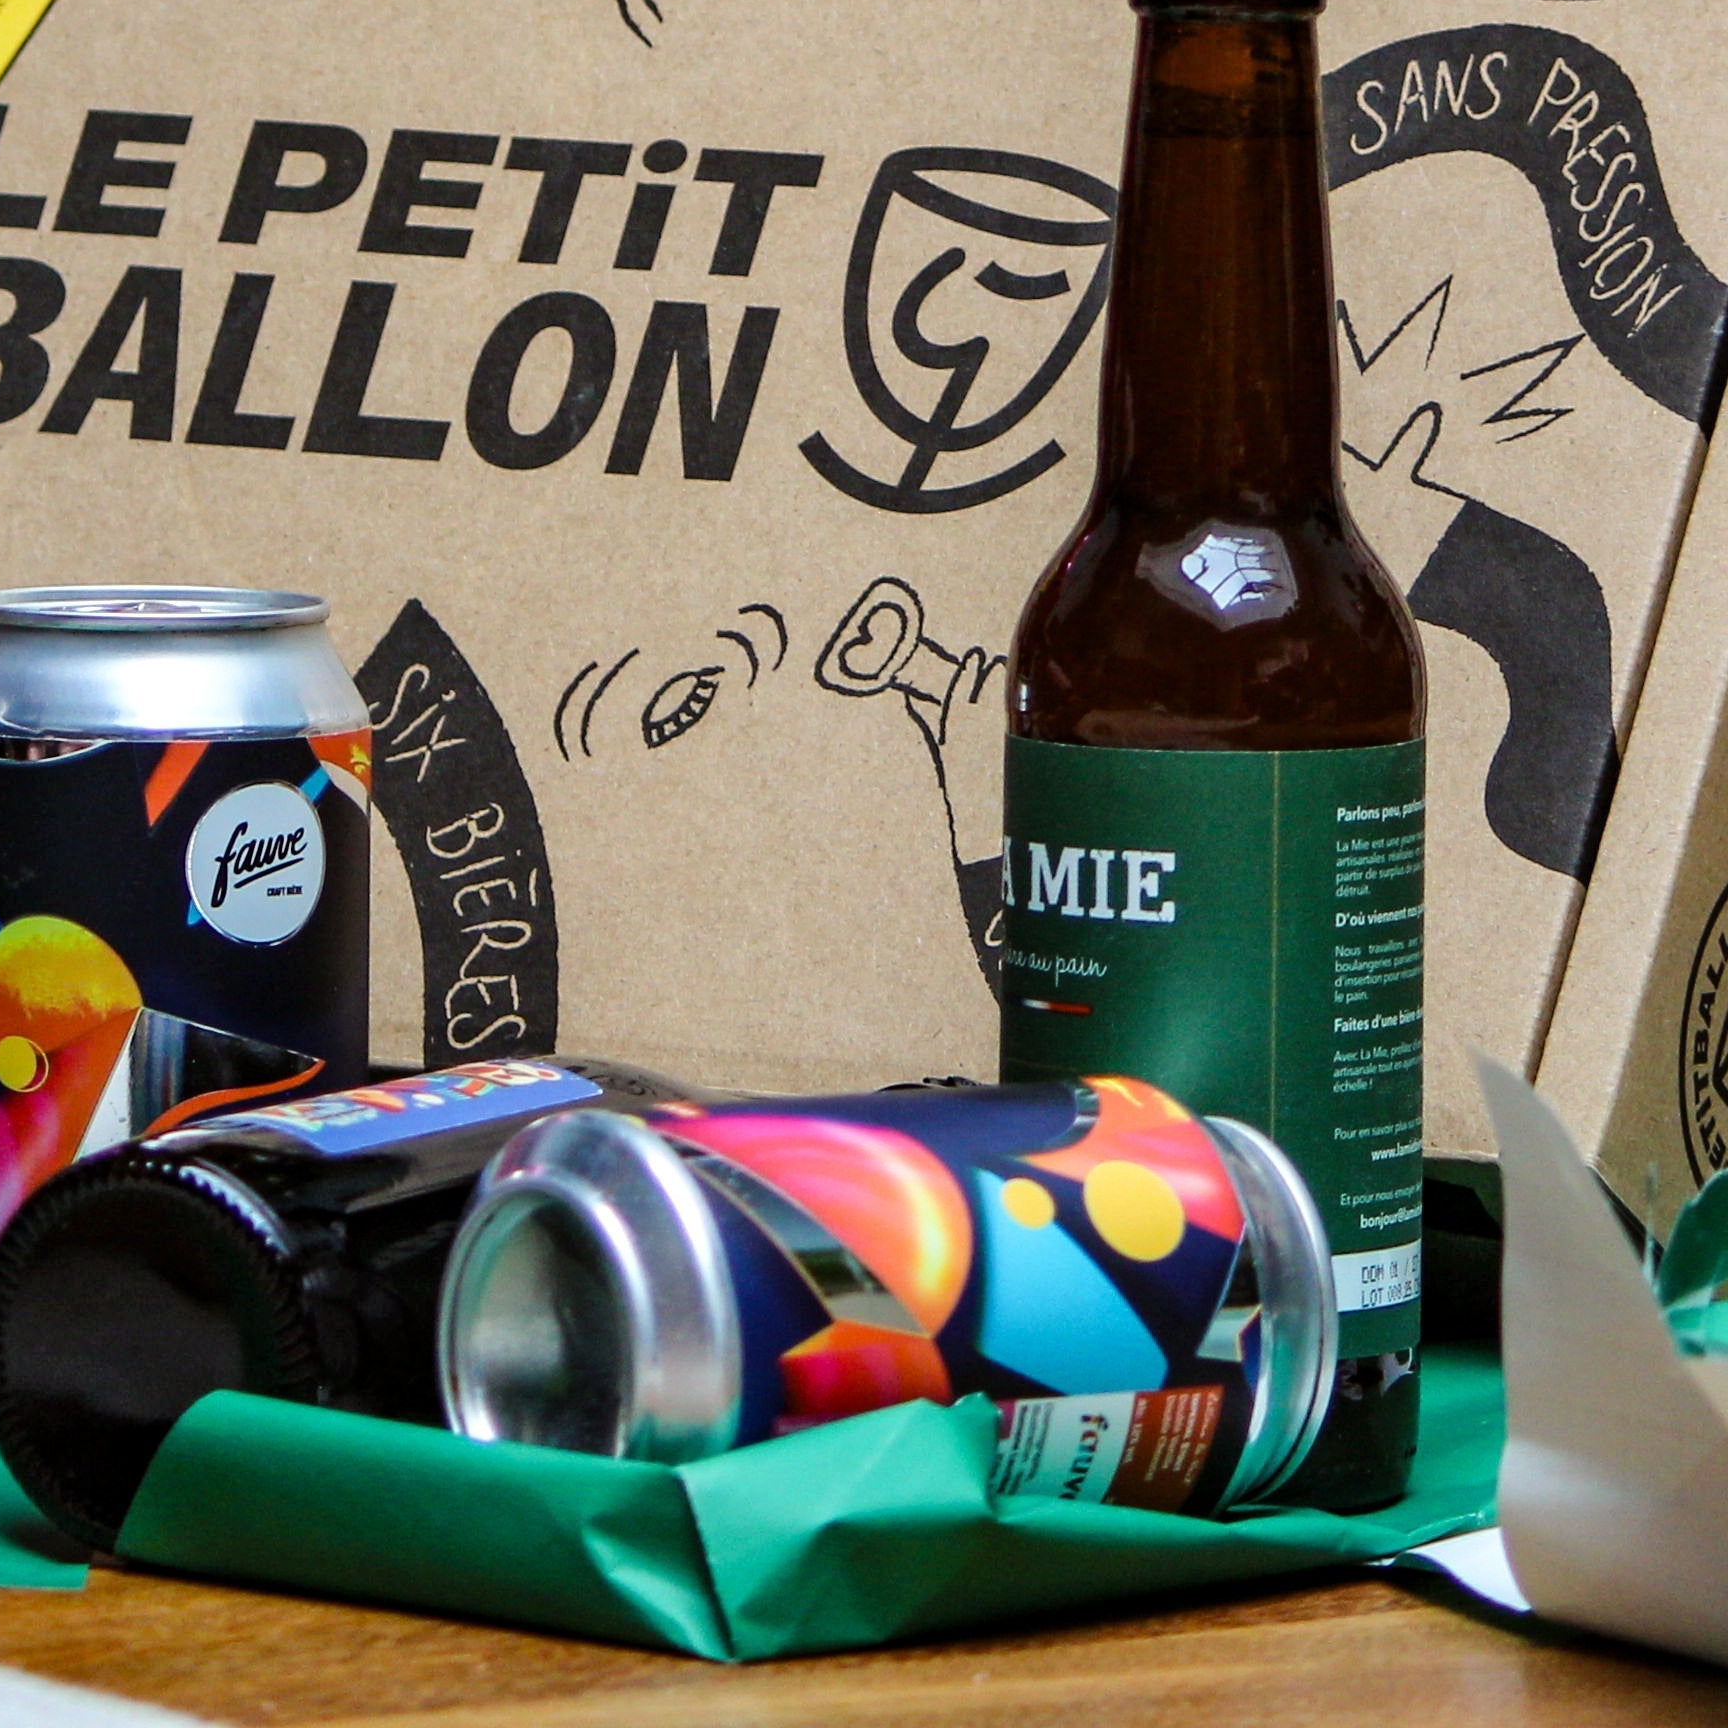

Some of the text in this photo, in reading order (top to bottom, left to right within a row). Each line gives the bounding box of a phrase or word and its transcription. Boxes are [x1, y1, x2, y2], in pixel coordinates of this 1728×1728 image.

[1349, 51, 1685, 339] SANS PRESSION
[1336, 805, 1380, 823] Parlons
[210, 820, 309, 909] fauve
[1027, 841, 1177, 923] MIE
[1335, 945, 1362, 957] Nous
[1054, 951, 1108, 989] pain
[1334, 1016, 1370, 1033] Faites
[1334, 1126, 1357, 1140] Pour
